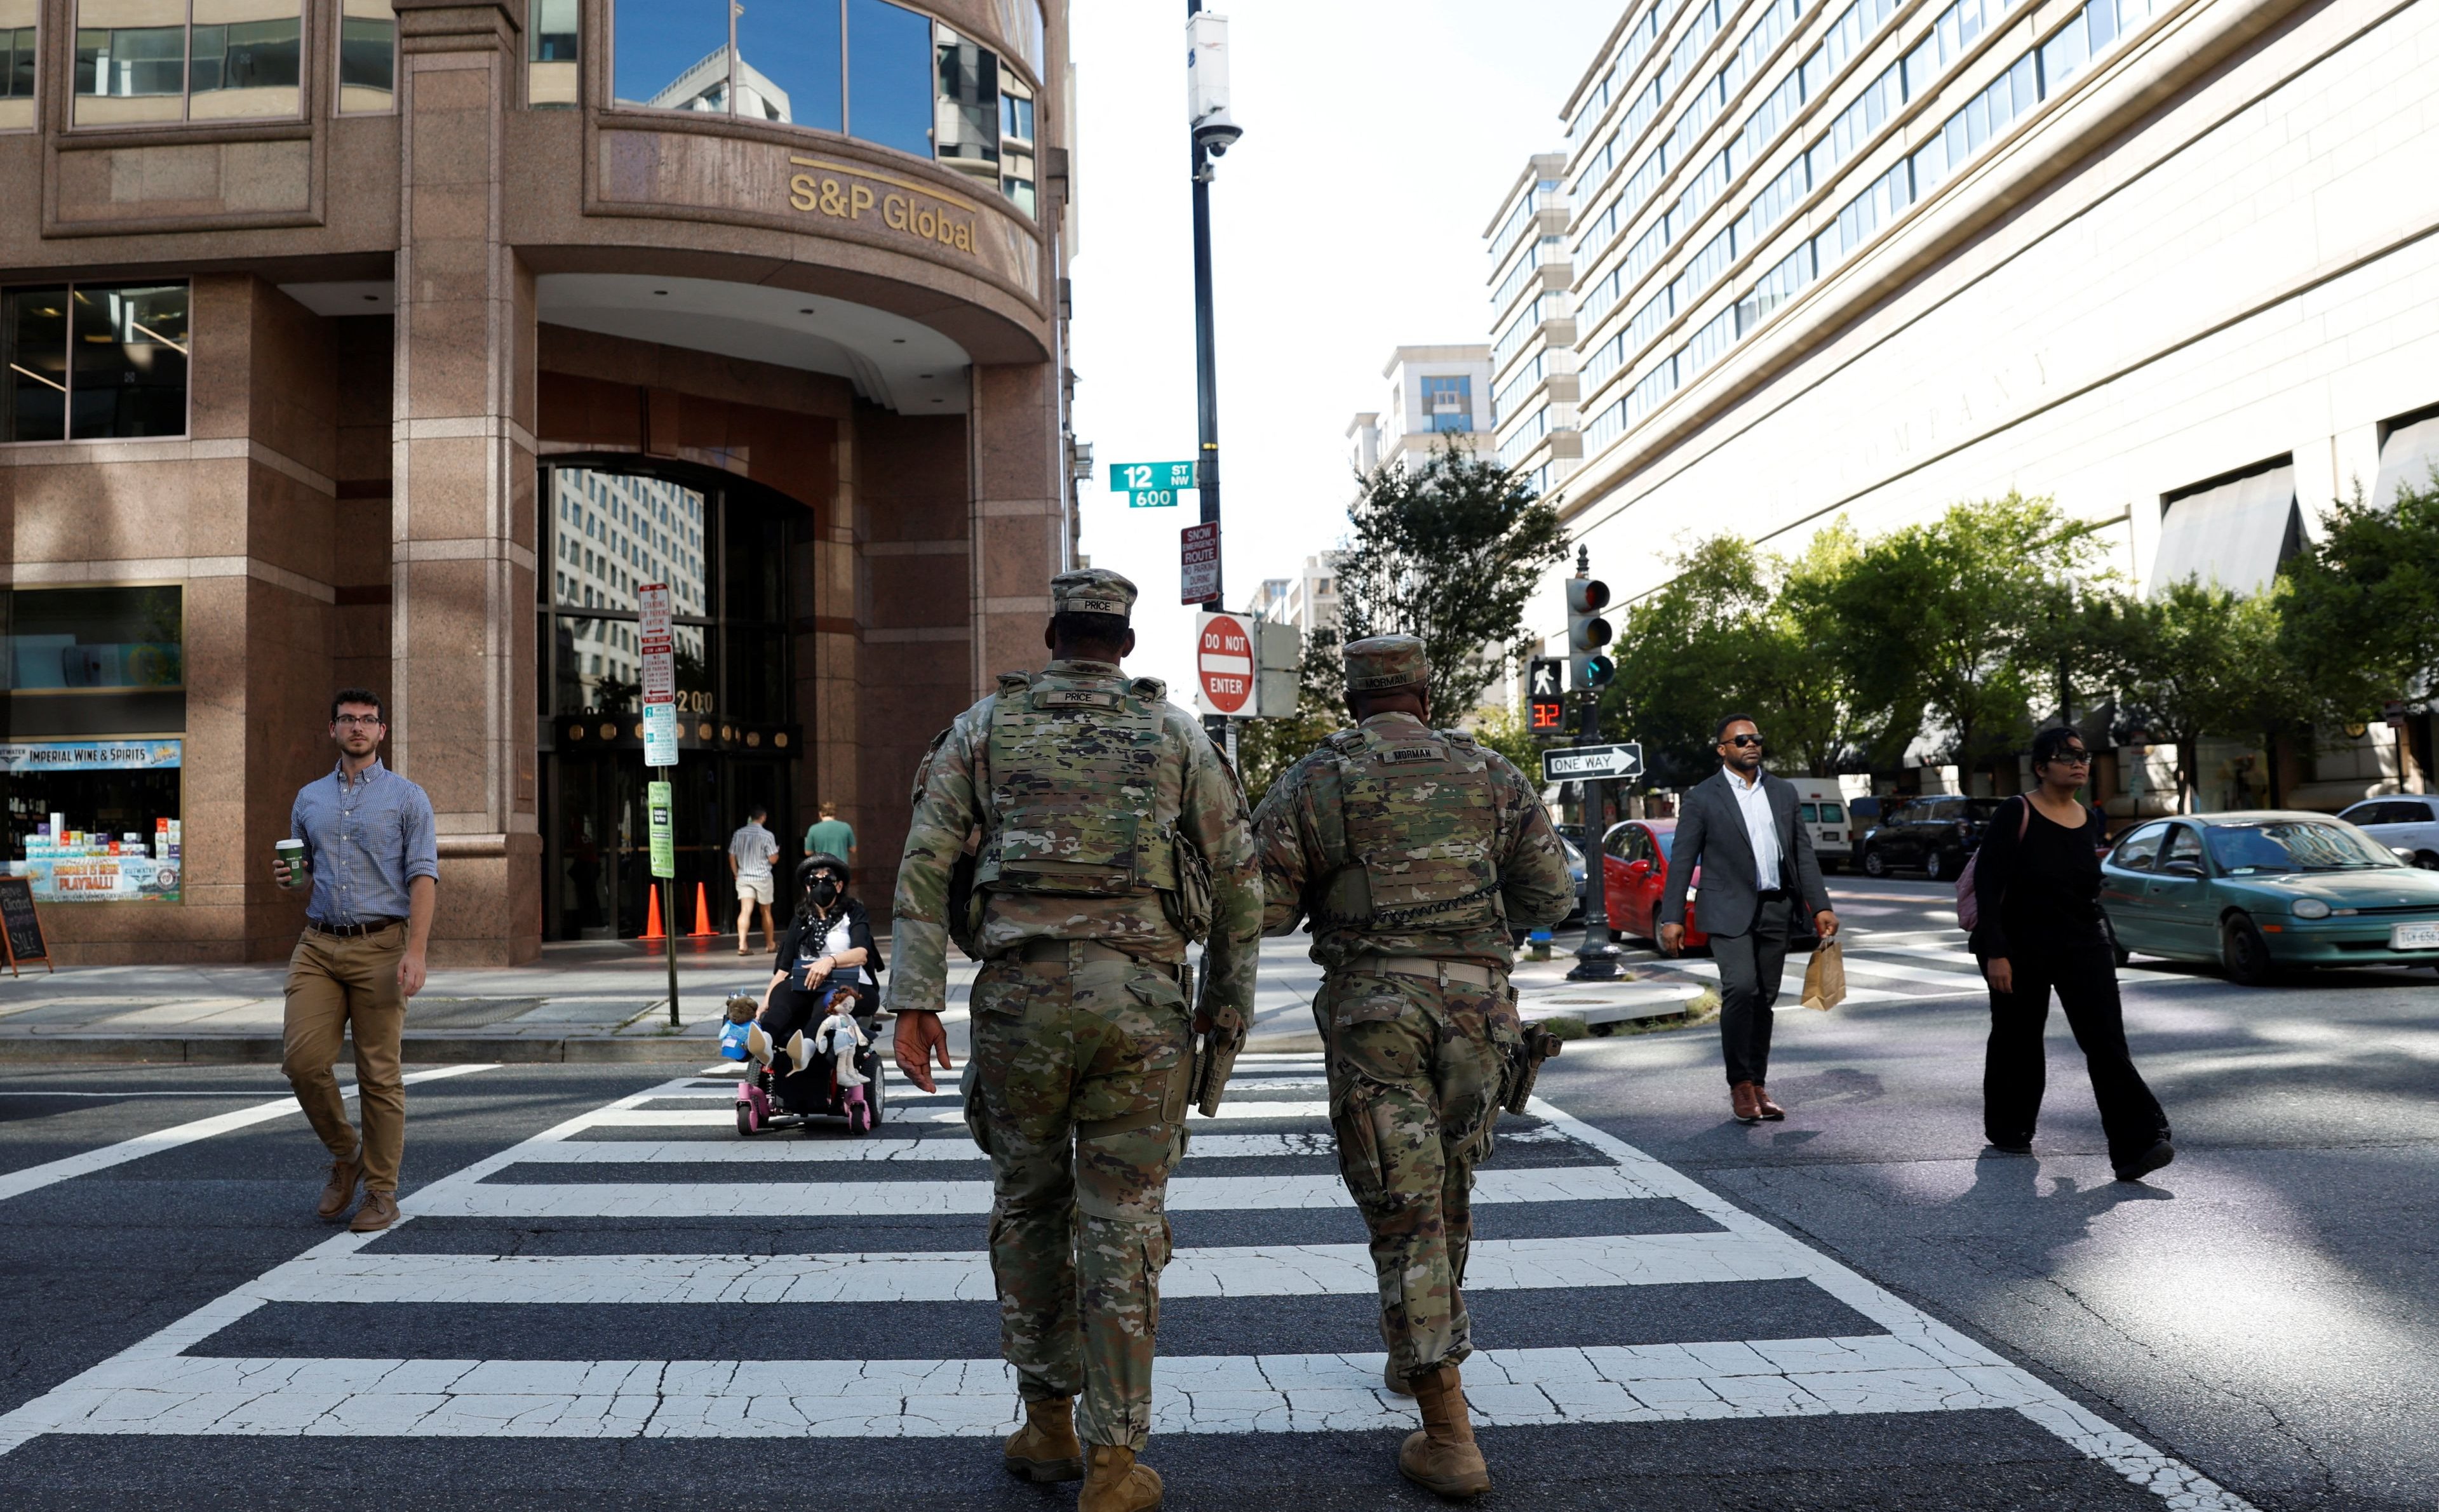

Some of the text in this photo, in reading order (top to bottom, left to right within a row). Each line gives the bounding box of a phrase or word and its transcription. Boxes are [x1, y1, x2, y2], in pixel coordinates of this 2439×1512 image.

[790, 174, 976, 255] S&P Global
[1123, 465, 1188, 488] 12 ST
[1171, 476, 1189, 486] NW
[1136, 490, 1171, 506] 600
[1187, 526, 1212, 542] SNOW
[1183, 539, 1216, 550] EMERGENCY
[1185, 548, 1214, 564] ROUTE
[1183, 561, 1216, 575] NO PARKING
[1190, 573, 1210, 585] DURING
[1183, 583, 1216, 596] EMERGENCY
[1084, 601, 1111, 611] PRICE
[1205, 633, 1246, 652] DO NOT
[1210, 678, 1243, 695] ENTER
[1366, 674, 1407, 688] MORMAN
[1065, 692, 1092, 702] PRICE
[1533, 704, 1559, 727] 32
[30, 749, 71, 762] IMPERIAL
[74, 748, 97, 761] WINE
[100, 750, 107, 760] &
[111, 748, 145, 761] SPIRITS
[1394, 749, 1431, 760] MORMAN
[1555, 756, 1611, 771] ONE WAY
